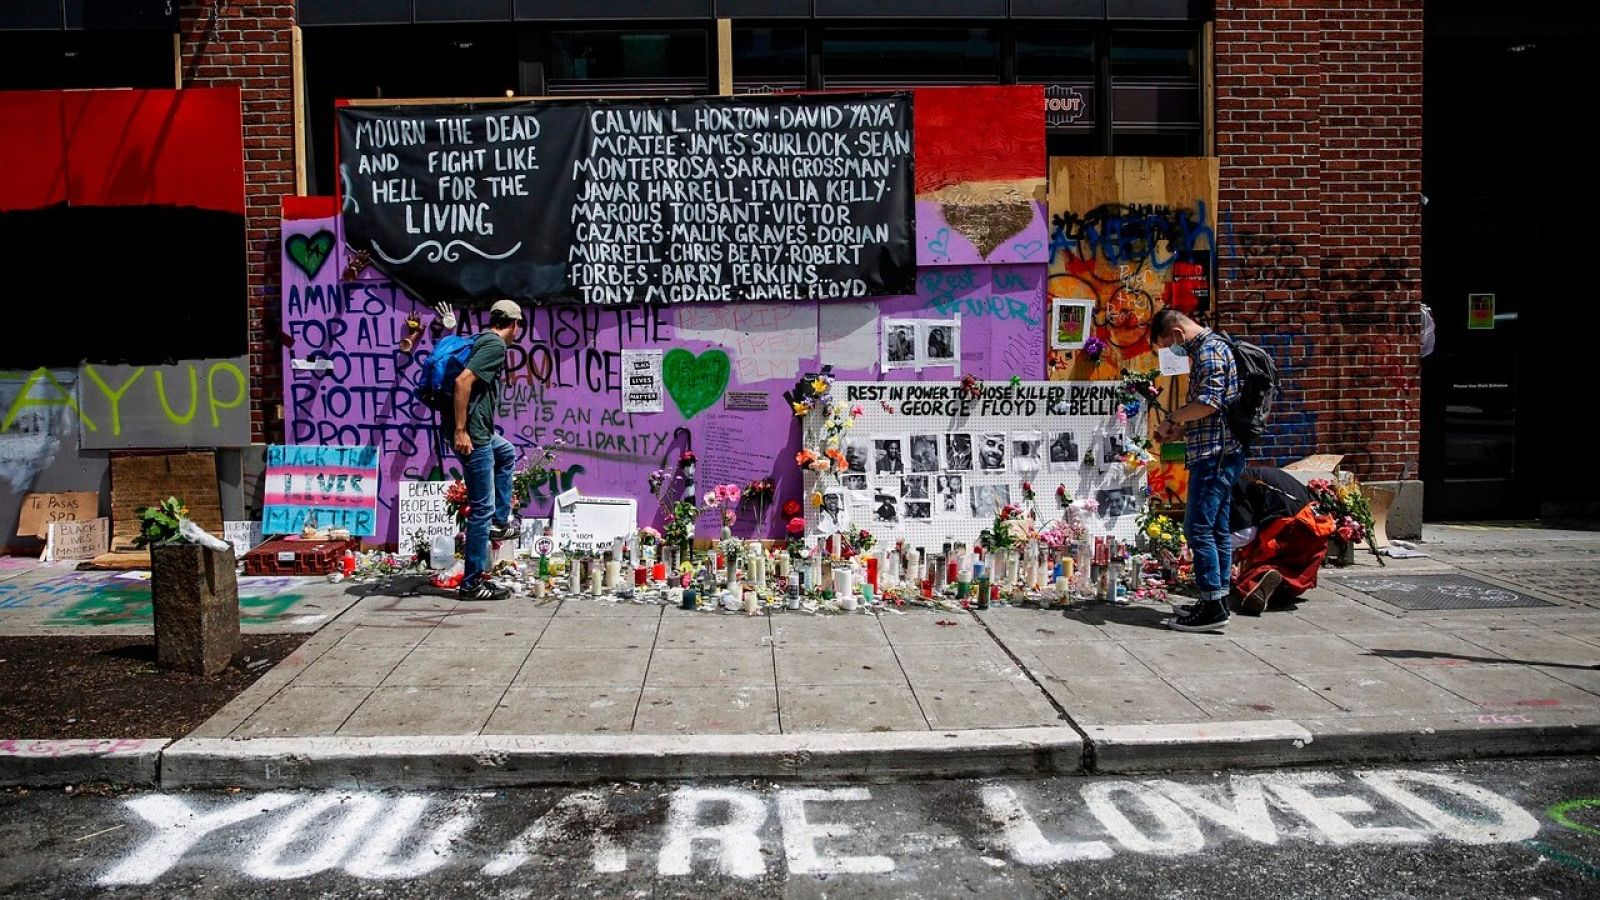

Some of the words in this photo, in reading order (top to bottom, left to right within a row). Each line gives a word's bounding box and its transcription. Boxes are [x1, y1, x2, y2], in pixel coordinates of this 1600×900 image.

[591, 110, 662, 134] CALVIN
[695, 107, 770, 131] HORTON
[780, 106, 843, 130] DAVID
[355, 119, 426, 149] MOURN
[435, 118, 473, 145] THE
[486, 116, 540, 143] DEAD
[591, 135, 678, 157] MCATEE
[687, 133, 749, 156] JAMES
[752, 131, 850, 156] SCURLOCK
[859, 130, 910, 156] SEAN
[359, 153, 399, 174] AND
[428, 150, 486, 173] FIGHT
[495, 146, 539, 171] LIKE
[724, 156, 789, 178] SARAH
[372, 178, 423, 204] HELL
[439, 176, 478, 200] FOR
[482, 174, 529, 197] THE
[577, 179, 640, 201] JAVAR
[649, 180, 742, 203] HARRELL
[752, 179, 819, 201] ITALIA
[405, 203, 493, 235] LIVING
[571, 202, 662, 224] MARQUIS
[670, 202, 763, 224] TOUSANT
[772, 203, 850, 225] VICTOR
[576, 223, 664, 244] CAZARES
[671, 223, 731, 242] MALIK
[735, 223, 807, 244] GRAVES
[818, 223, 889, 244] DORIAN
[569, 244, 662, 264] MURRELL
[671, 243, 723, 262] CHRIS
[729, 244, 783, 263] BEATY
[791, 245, 864, 265] ROBERT
[662, 264, 721, 285] BARRY
[288, 284, 417, 316] AMNEST
[578, 285, 634, 304] TONY
[745, 284, 804, 300] JAMEL
[809, 279, 867, 300] FLOYD
[288, 319, 348, 350] FOR
[603, 305, 671, 348] THE
[503, 344, 622, 393] POLICE
[154, 361, 247, 428] UP
[630, 393, 657, 401] MATTER
[847, 386, 887, 400] REST
[890, 386, 903, 400] IN
[906, 386, 949, 400] POWER
[951, 387, 966, 399] TO
[967, 386, 1011, 400] HOSE
[1017, 386, 1066, 400] KILLED
[534, 405, 555, 422] IS
[561, 408, 591, 424] AN
[901, 400, 971, 416] GEORGE
[981, 400, 1036, 416] FLOYD
[521, 424, 546, 443] OF
[269, 446, 327, 467] BLACK
[284, 473, 364, 501] LIVES
[408, 483, 446, 497] BLACK
[60, 525, 96, 535] BLACK
[400, 513, 454, 526] EXISTENCE
[97, 793, 480, 889] YOU
[480, 787, 895, 878] ARE
[978, 768, 1540, 865] LOVED
